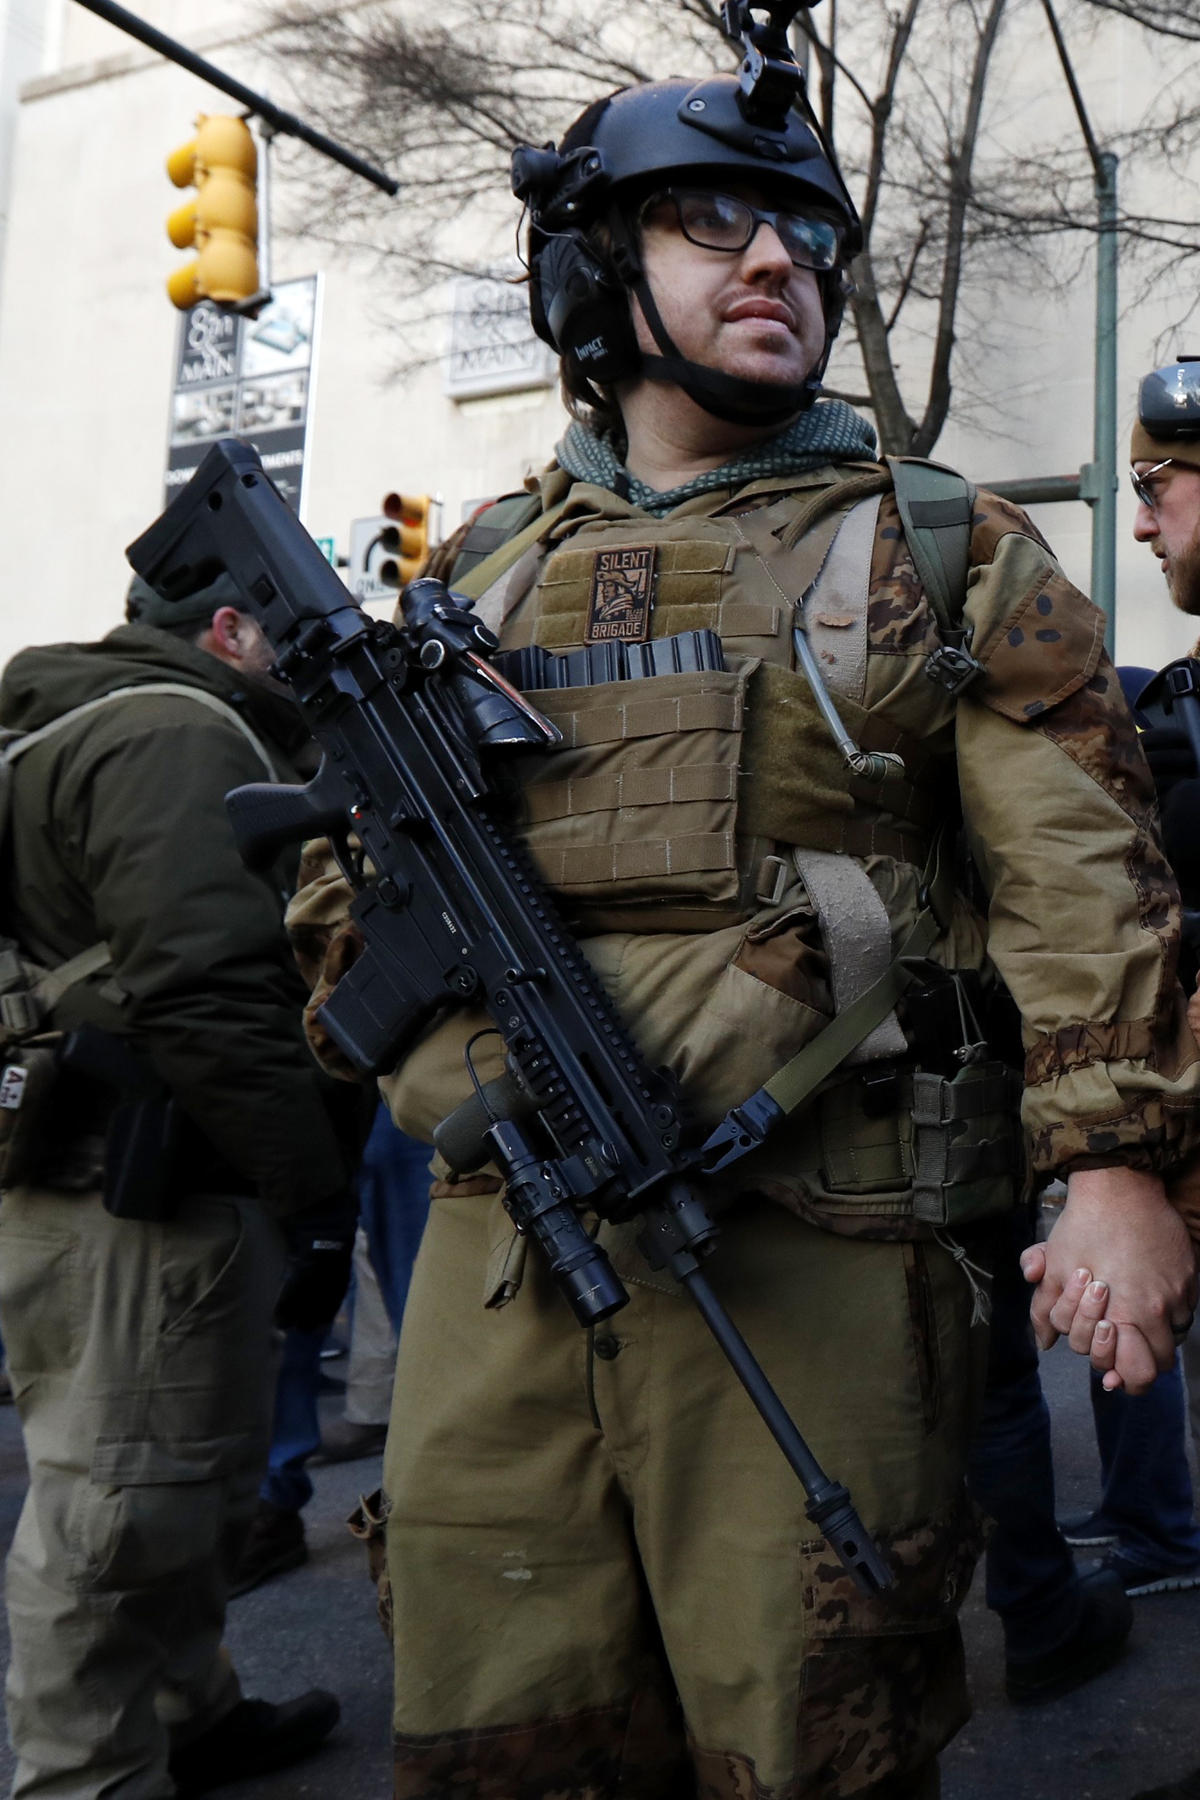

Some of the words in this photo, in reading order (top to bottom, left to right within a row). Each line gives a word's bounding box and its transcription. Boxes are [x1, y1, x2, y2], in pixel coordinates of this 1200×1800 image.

[180, 353, 234, 382] MAIN
[600, 551, 650, 571] SILENT
[591, 622, 642, 639] BRIGADE
